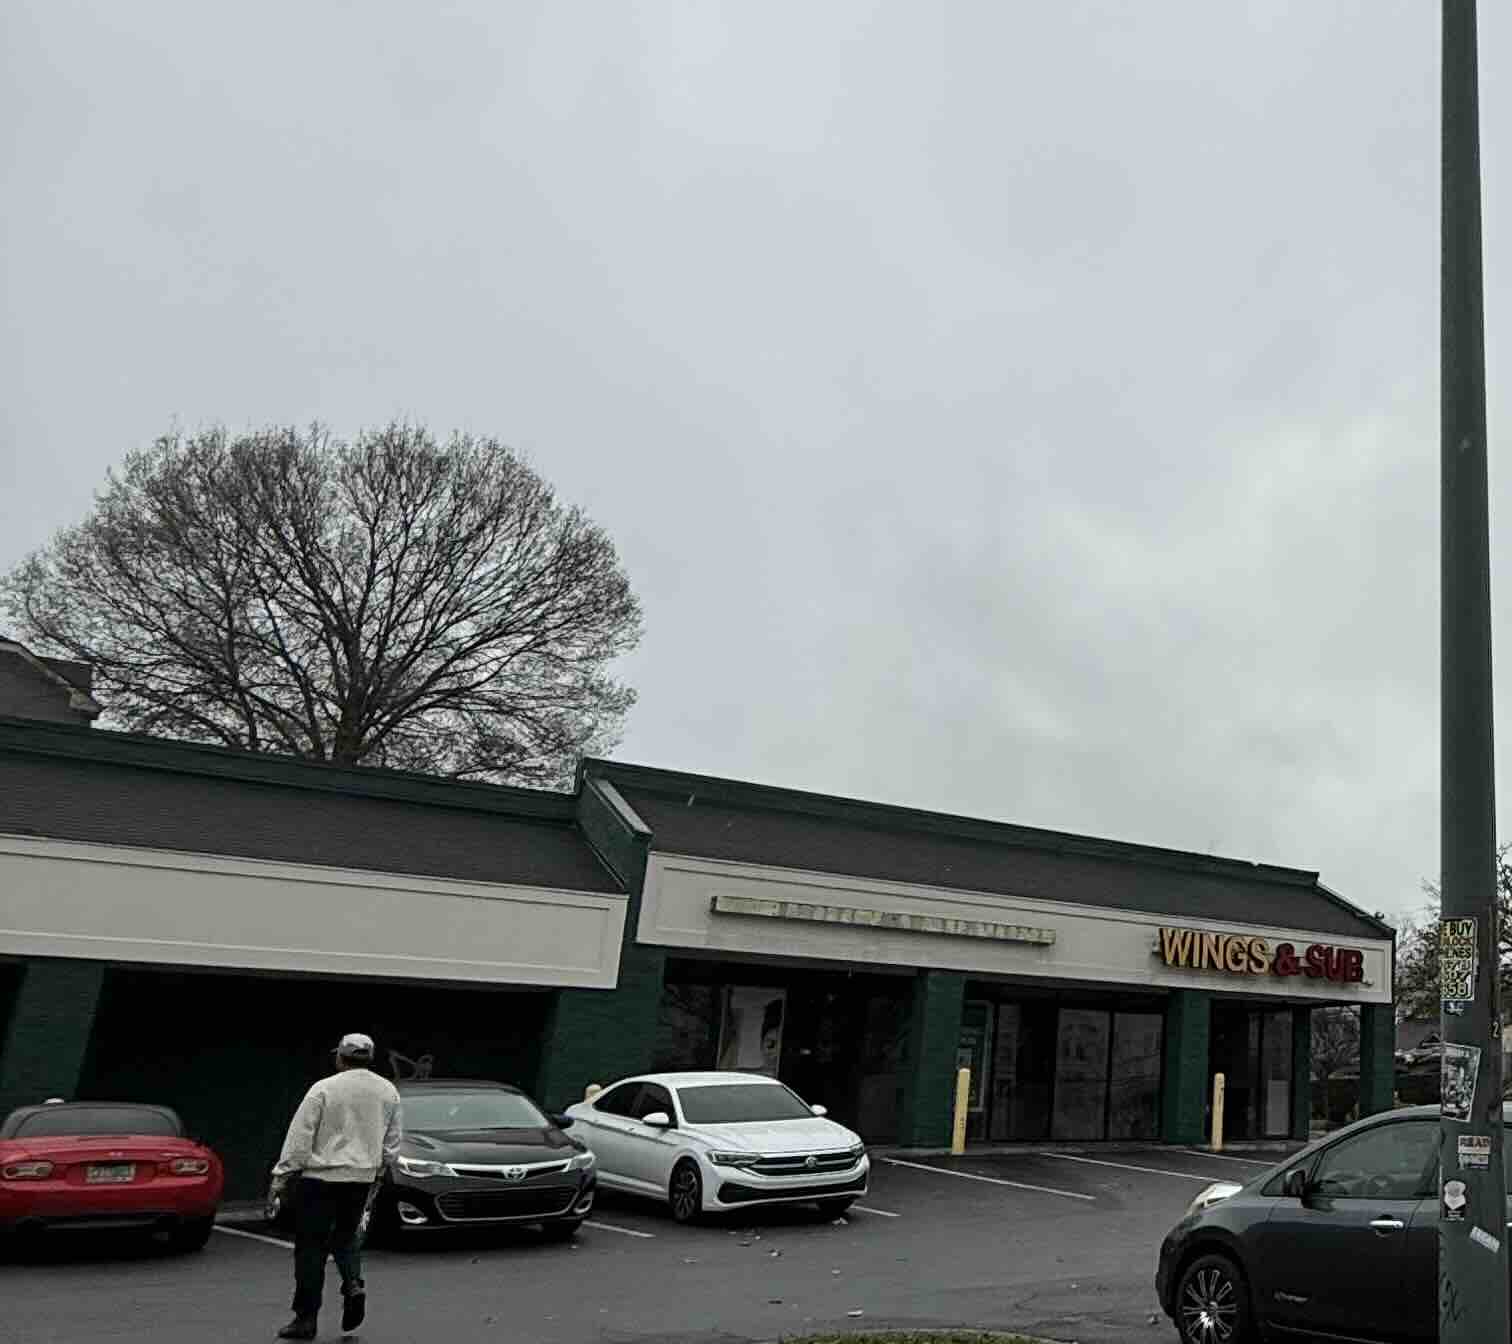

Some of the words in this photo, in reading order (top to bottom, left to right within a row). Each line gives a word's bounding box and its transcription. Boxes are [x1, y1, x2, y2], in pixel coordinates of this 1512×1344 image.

[1449, 920, 1473, 936] BUY
[1159, 927, 1271, 975] WINGS
[1273, 943, 1299, 976] &
[1304, 944, 1364, 983] SUB
